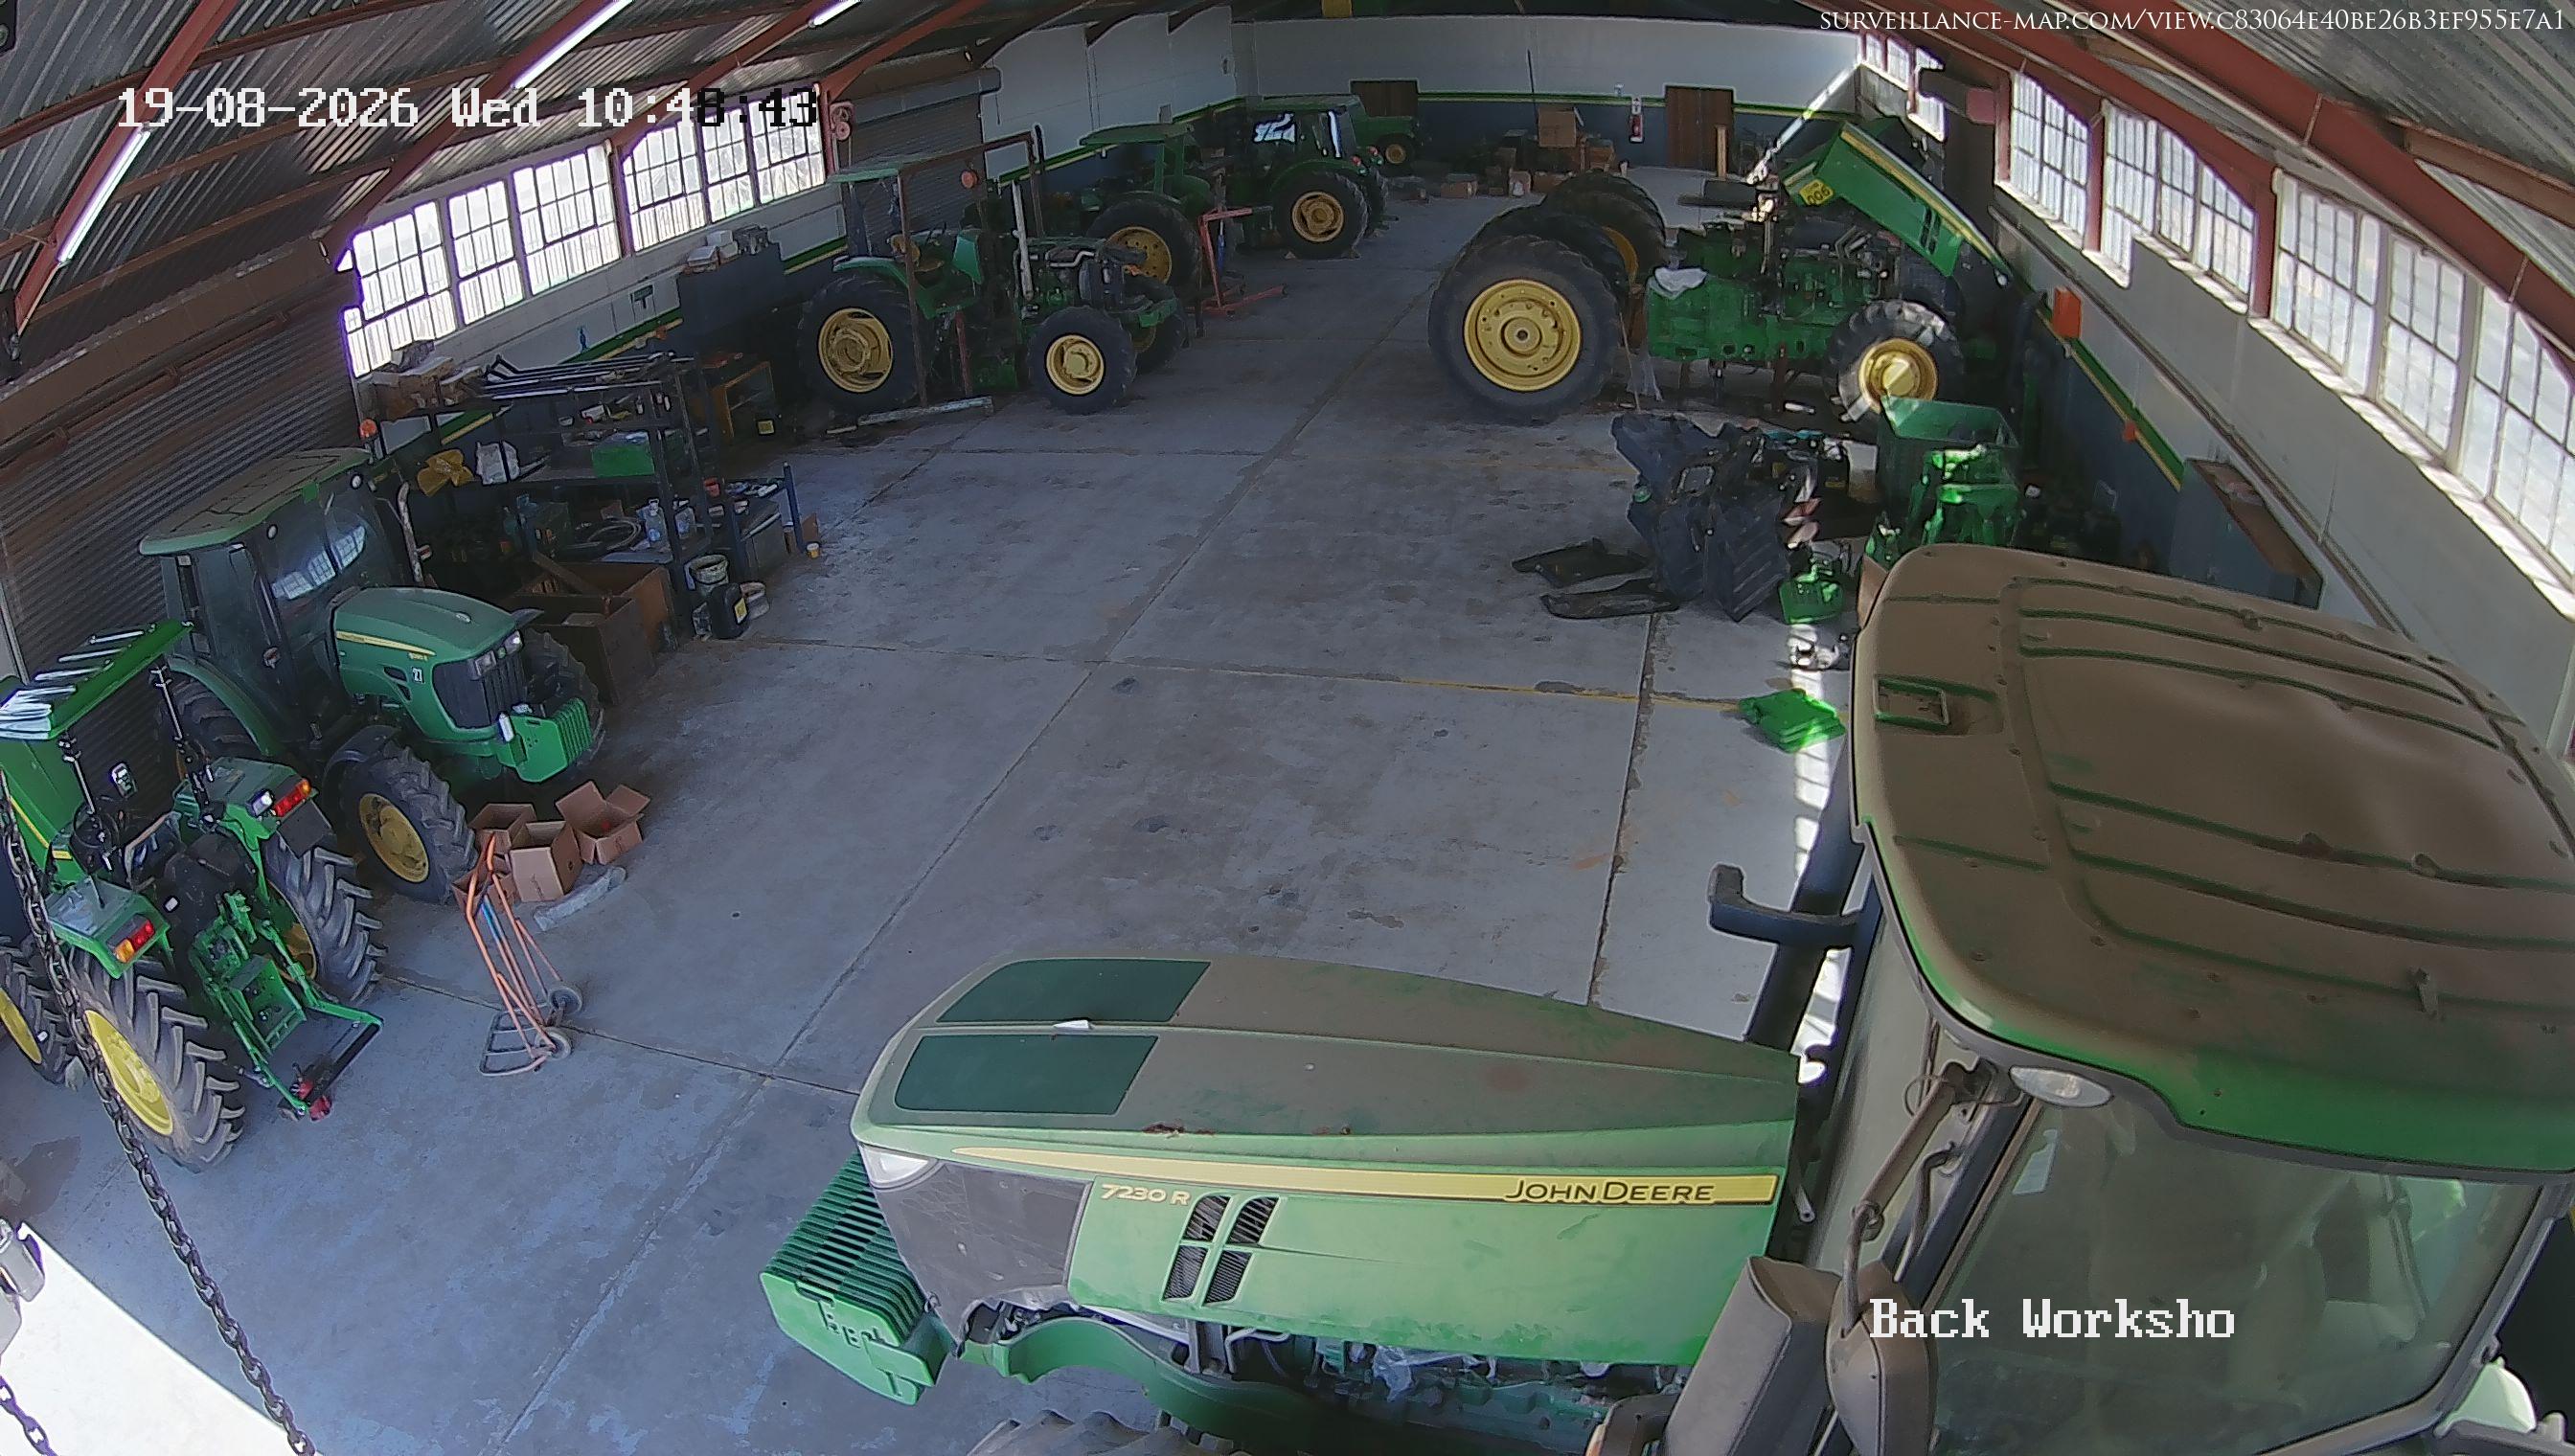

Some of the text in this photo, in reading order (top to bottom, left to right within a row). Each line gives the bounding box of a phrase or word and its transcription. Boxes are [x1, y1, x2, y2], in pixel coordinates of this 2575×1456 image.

[1101, 1183, 1191, 1206] 7230 R
[1505, 1179, 1716, 1201] JOHN DEERE
